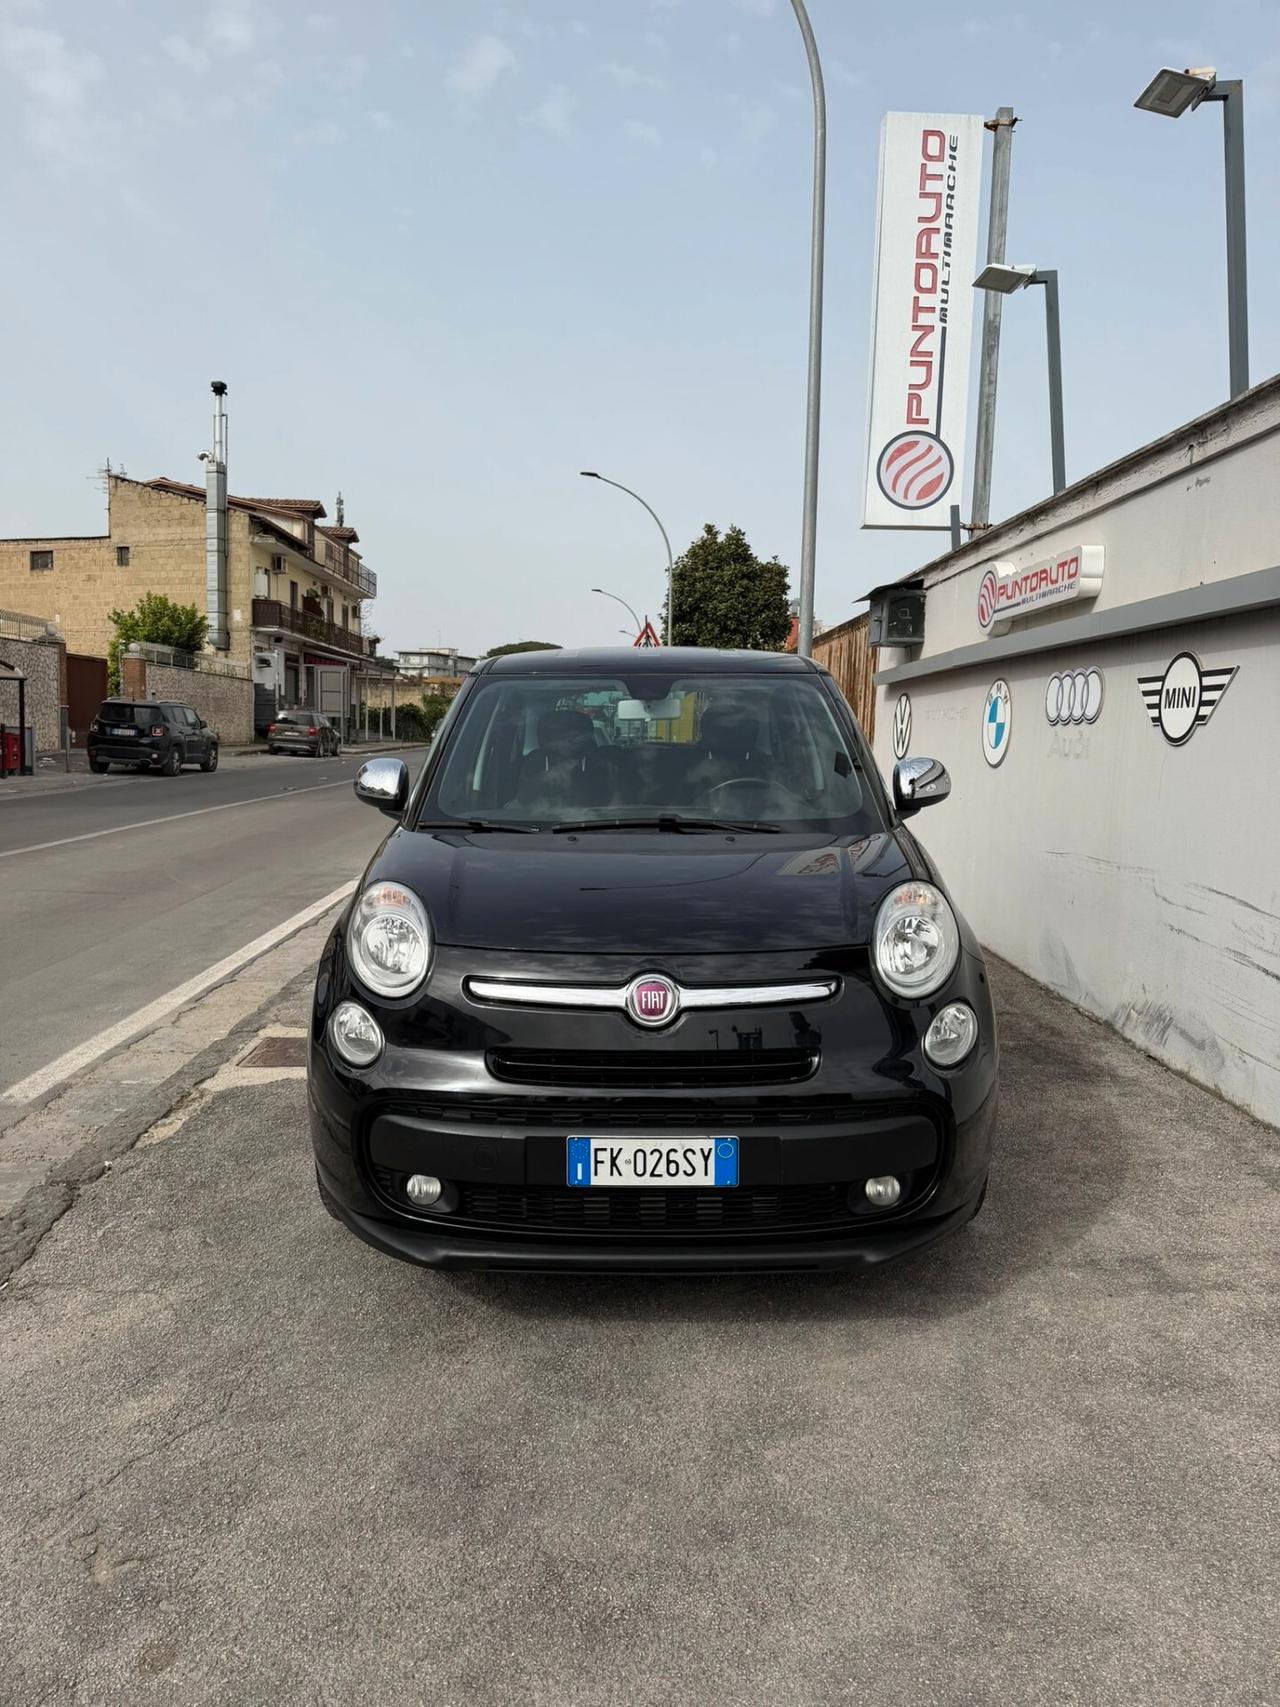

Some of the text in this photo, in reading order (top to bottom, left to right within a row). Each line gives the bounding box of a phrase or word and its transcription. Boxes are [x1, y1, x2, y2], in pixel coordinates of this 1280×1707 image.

[939, 134, 959, 324] MULTIMARCHE
[906, 129, 946, 426] PUNTOAUTO
[997, 556, 1079, 604] PUNTOAUTO
[1164, 686, 1197, 709] MINI
[641, 990, 666, 1010] FIAT
